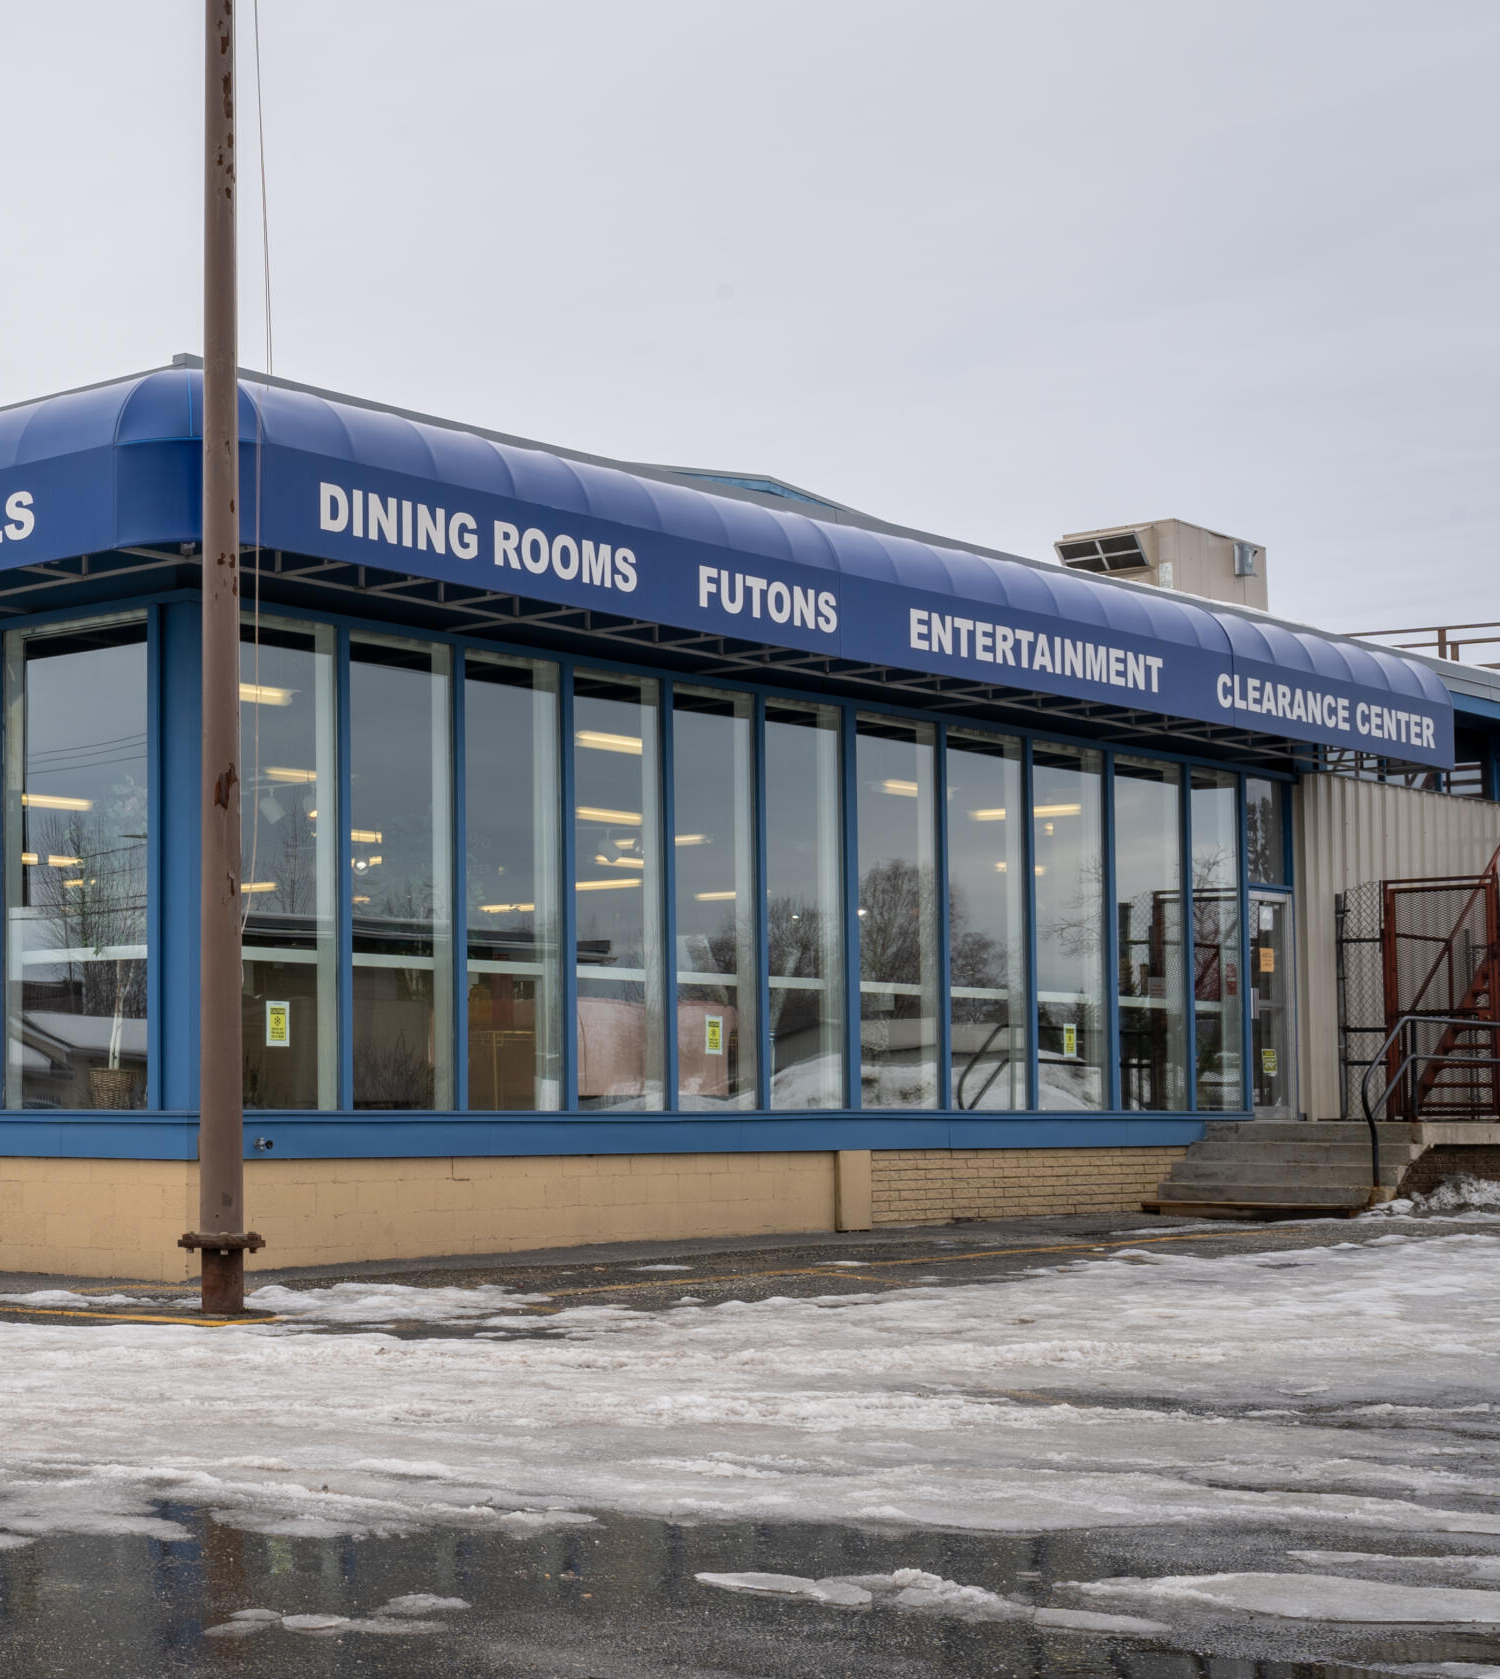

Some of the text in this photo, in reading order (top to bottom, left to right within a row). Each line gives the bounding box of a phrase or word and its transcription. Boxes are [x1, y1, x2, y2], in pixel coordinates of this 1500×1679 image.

[318, 481, 638, 592] DINING ROOMS
[699, 565, 839, 633] FUTONS
[909, 608, 1164, 693] ENTERTAINMENT
[1216, 673, 1436, 749] CLEARANCE CENTER
